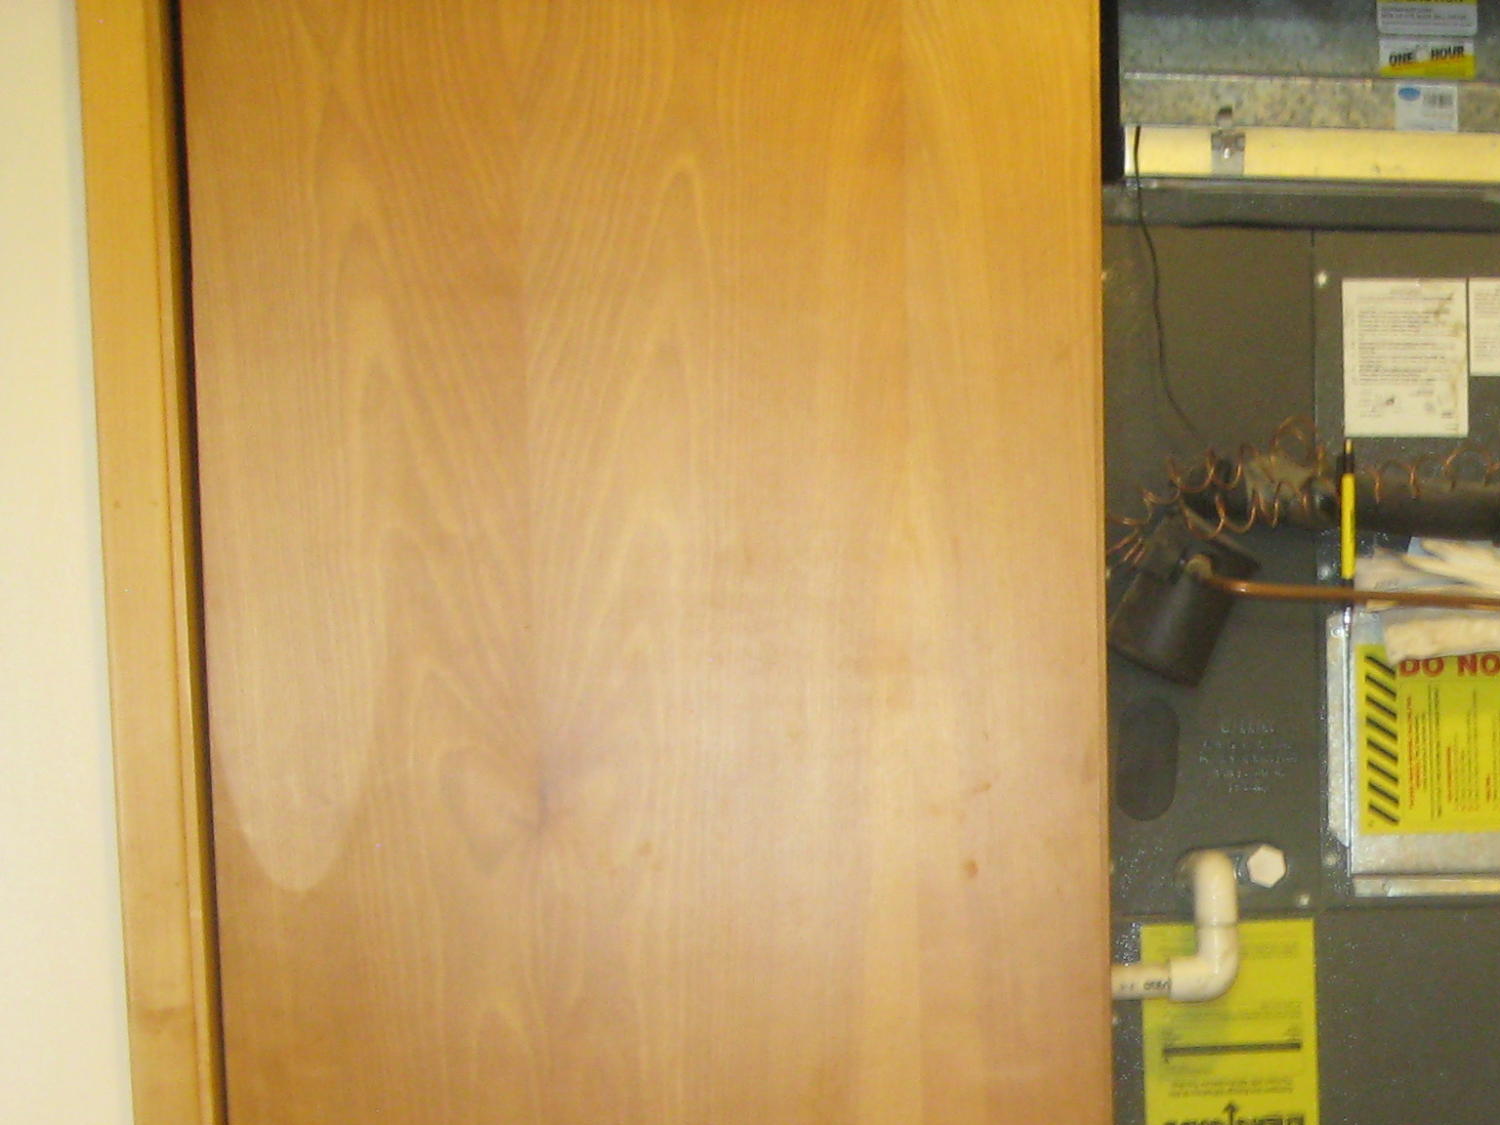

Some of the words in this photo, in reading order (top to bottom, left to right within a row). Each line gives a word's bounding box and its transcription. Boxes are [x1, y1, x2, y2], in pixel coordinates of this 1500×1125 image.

[1389, 52, 1414, 66] ONE
[1431, 45, 1464, 60] HOUR
[1400, 657, 1445, 677] DO
